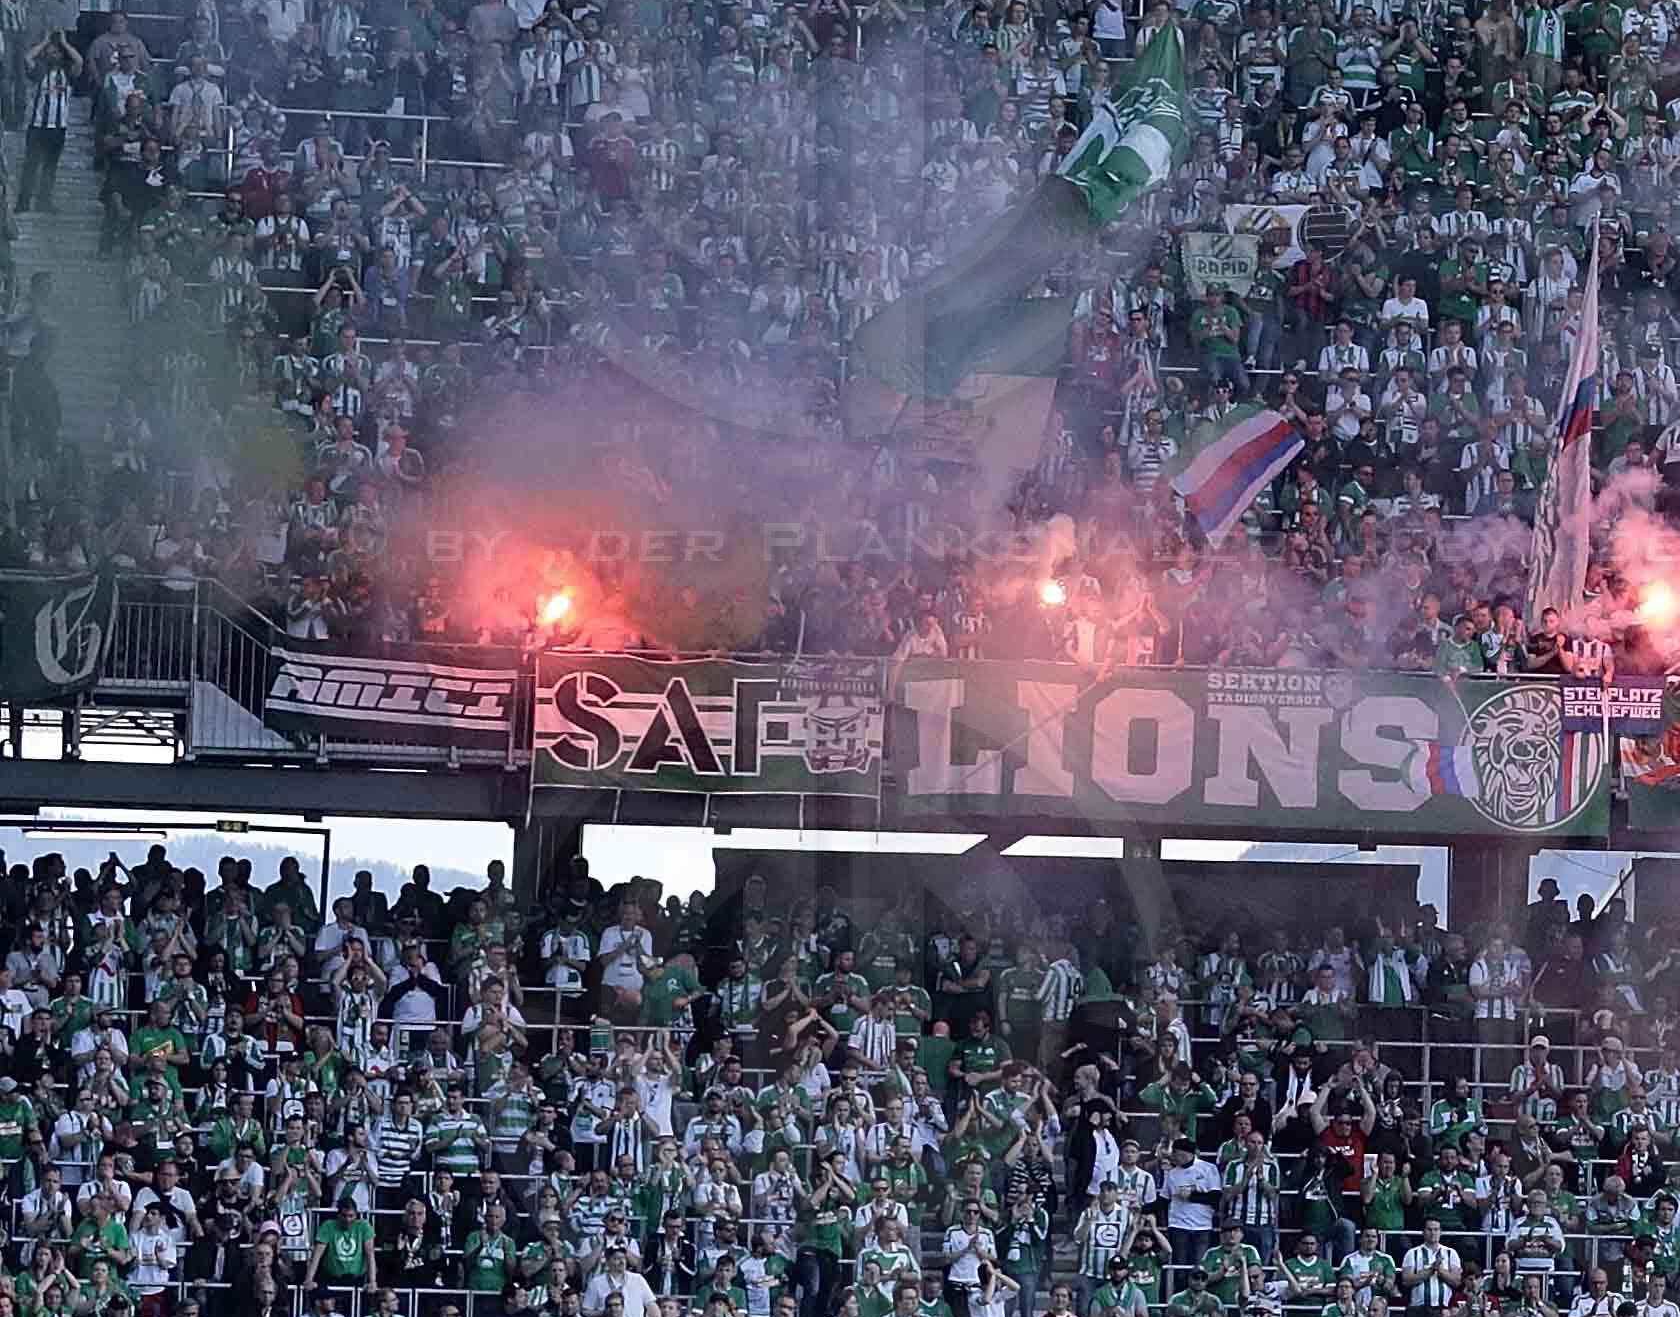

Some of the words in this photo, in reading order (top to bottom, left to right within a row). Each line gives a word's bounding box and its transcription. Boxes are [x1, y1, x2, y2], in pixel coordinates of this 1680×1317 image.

[1198, 261, 1249, 275] RAPID
[275, 665, 513, 718] AMICI
[1207, 673, 1322, 692] SEKTION
[905, 678, 1440, 813] LIONS
